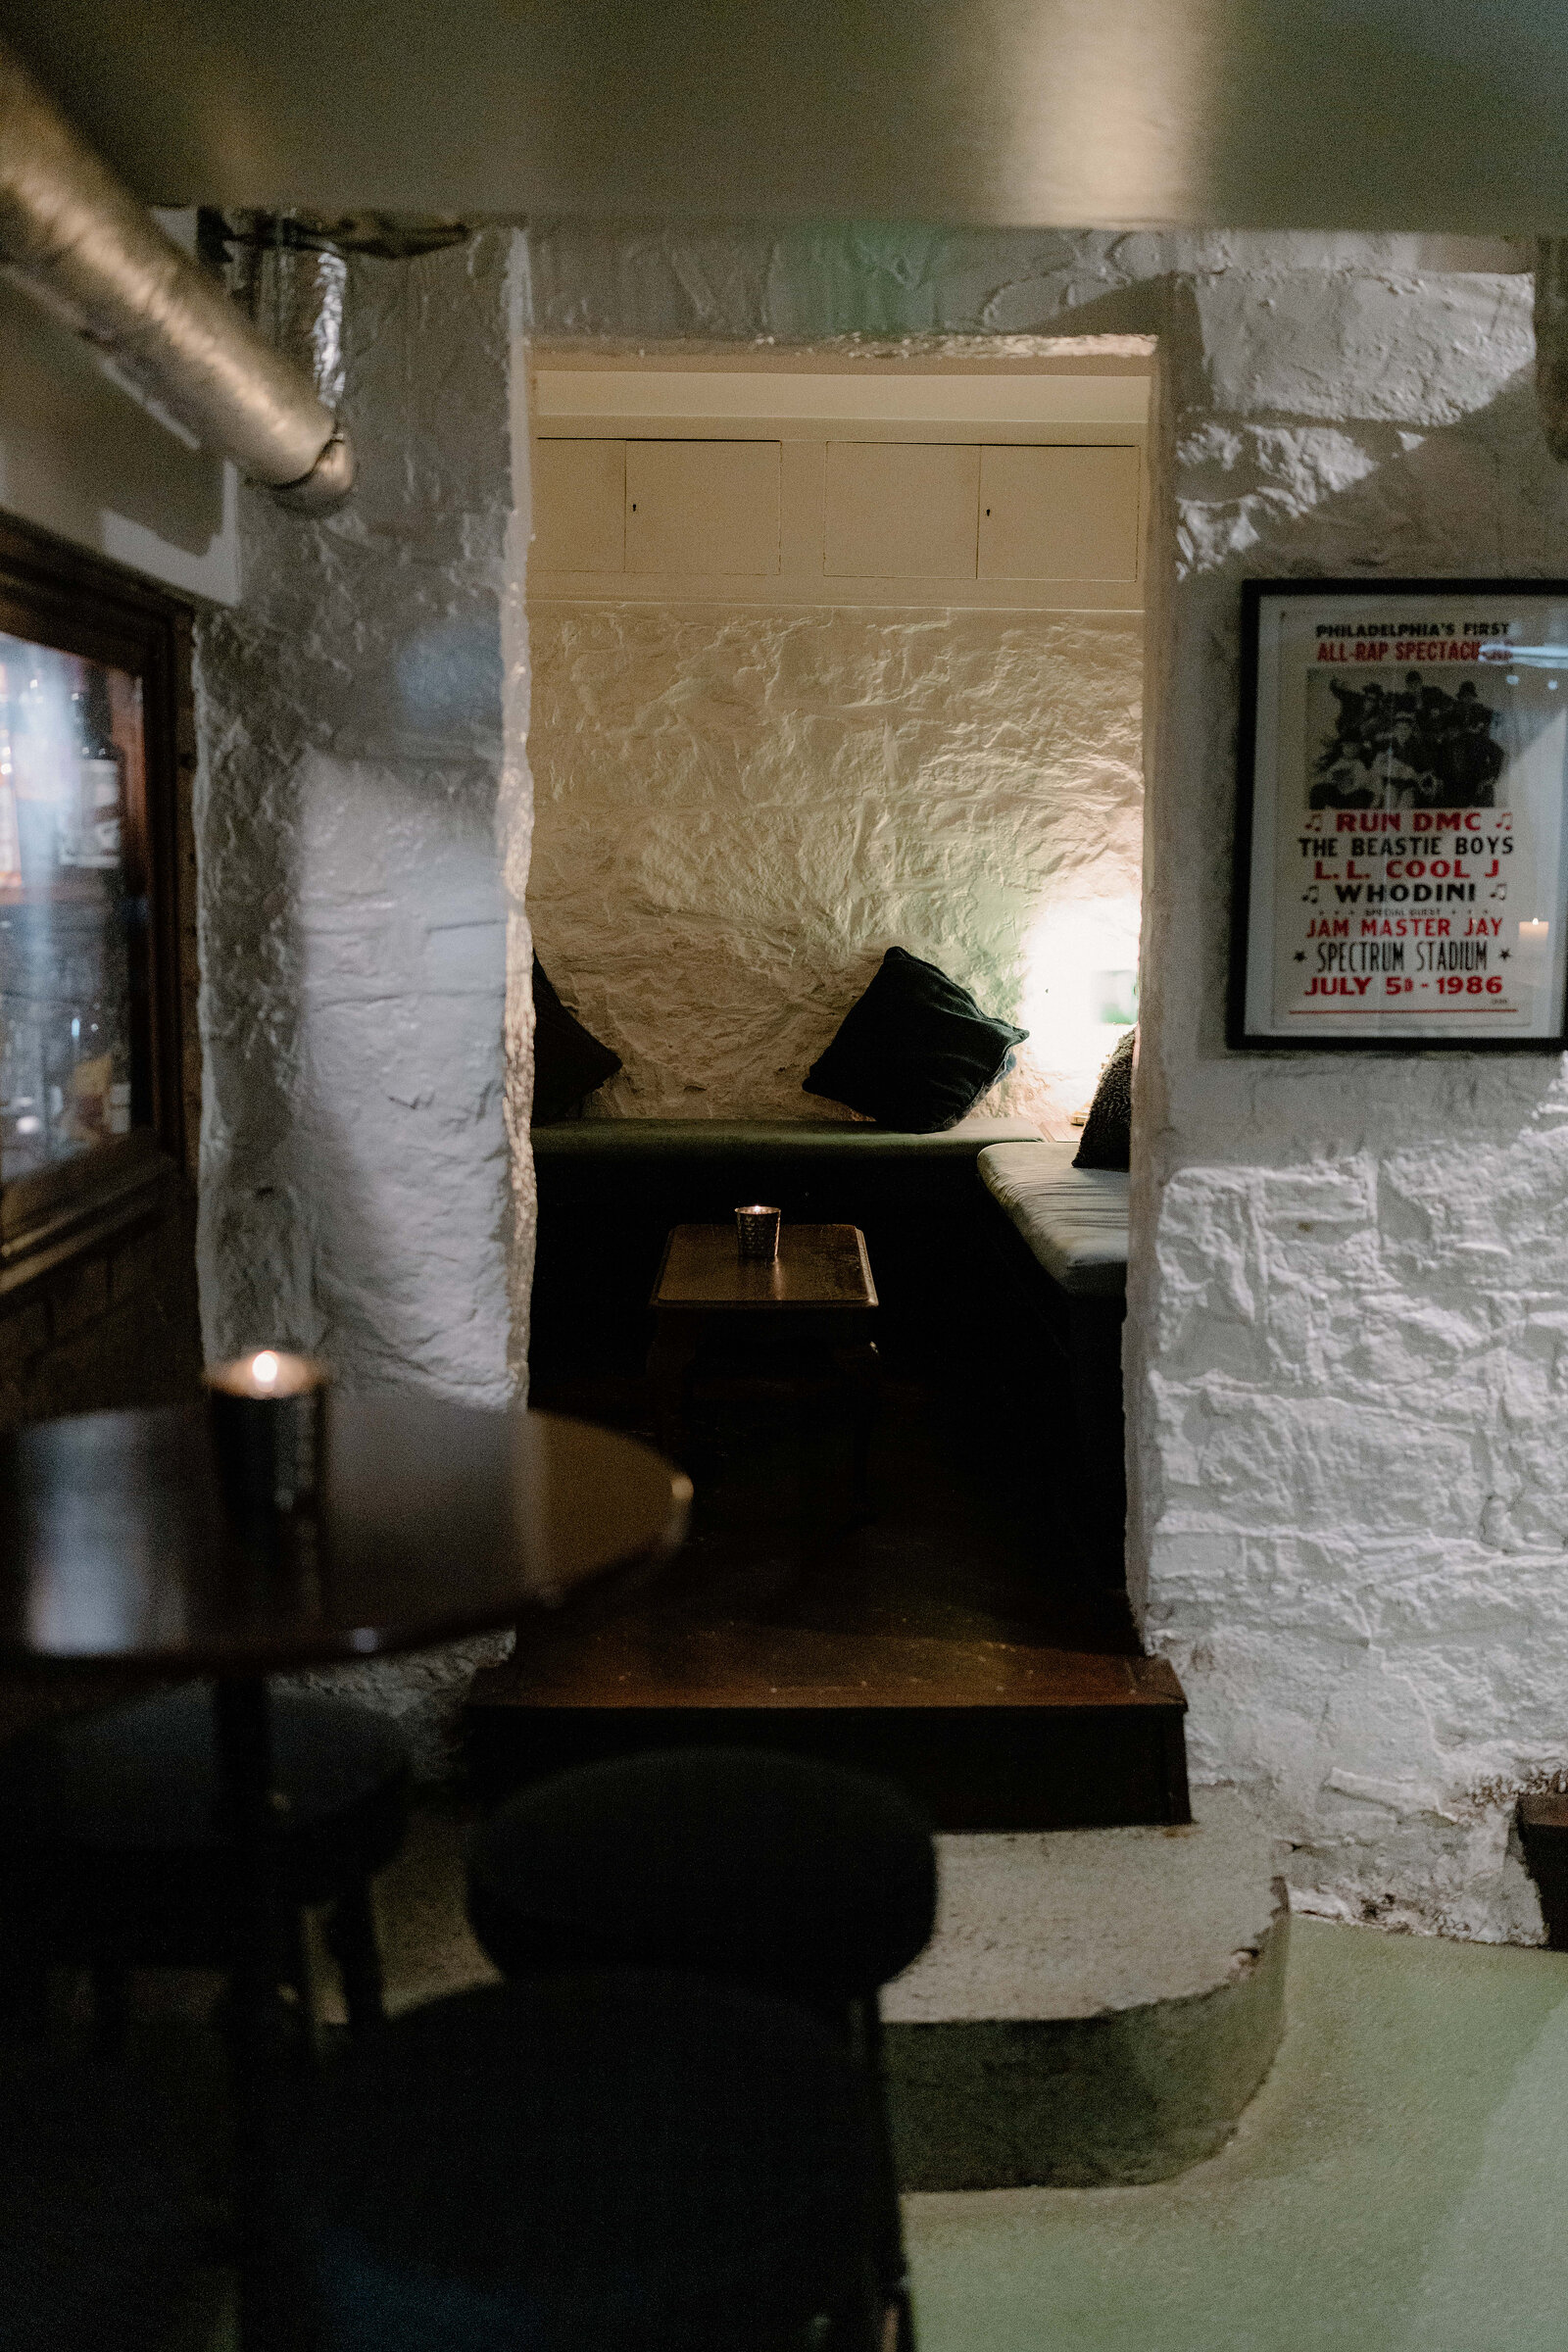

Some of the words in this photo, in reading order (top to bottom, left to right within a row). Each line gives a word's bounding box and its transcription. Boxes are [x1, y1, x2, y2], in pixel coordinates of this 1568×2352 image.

[1316, 623, 1455, 637] PHILADELPHIA'S
[1463, 622, 1510, 636] FIRST
[1317, 640, 1390, 662] ALL-RAP
[1336, 812, 1400, 832] RUN
[1413, 811, 1481, 831] DMC
[1298, 837, 1339, 858] THE
[1351, 836, 1442, 857] BEASTIE
[1455, 836, 1514, 855] BOYS
[1386, 858, 1470, 878] COOL
[1485, 858, 1499, 878] J
[1335, 883, 1476, 903] WHODINI
[1306, 918, 1349, 938] JAM
[1361, 918, 1450, 937] MASTER
[1464, 917, 1503, 936] JAY
[1318, 941, 1404, 973] SPECTRUM
[1416, 940, 1488, 971] STADIUM
[1304, 977, 1372, 996] JULY
[1437, 976, 1503, 995] 1986
